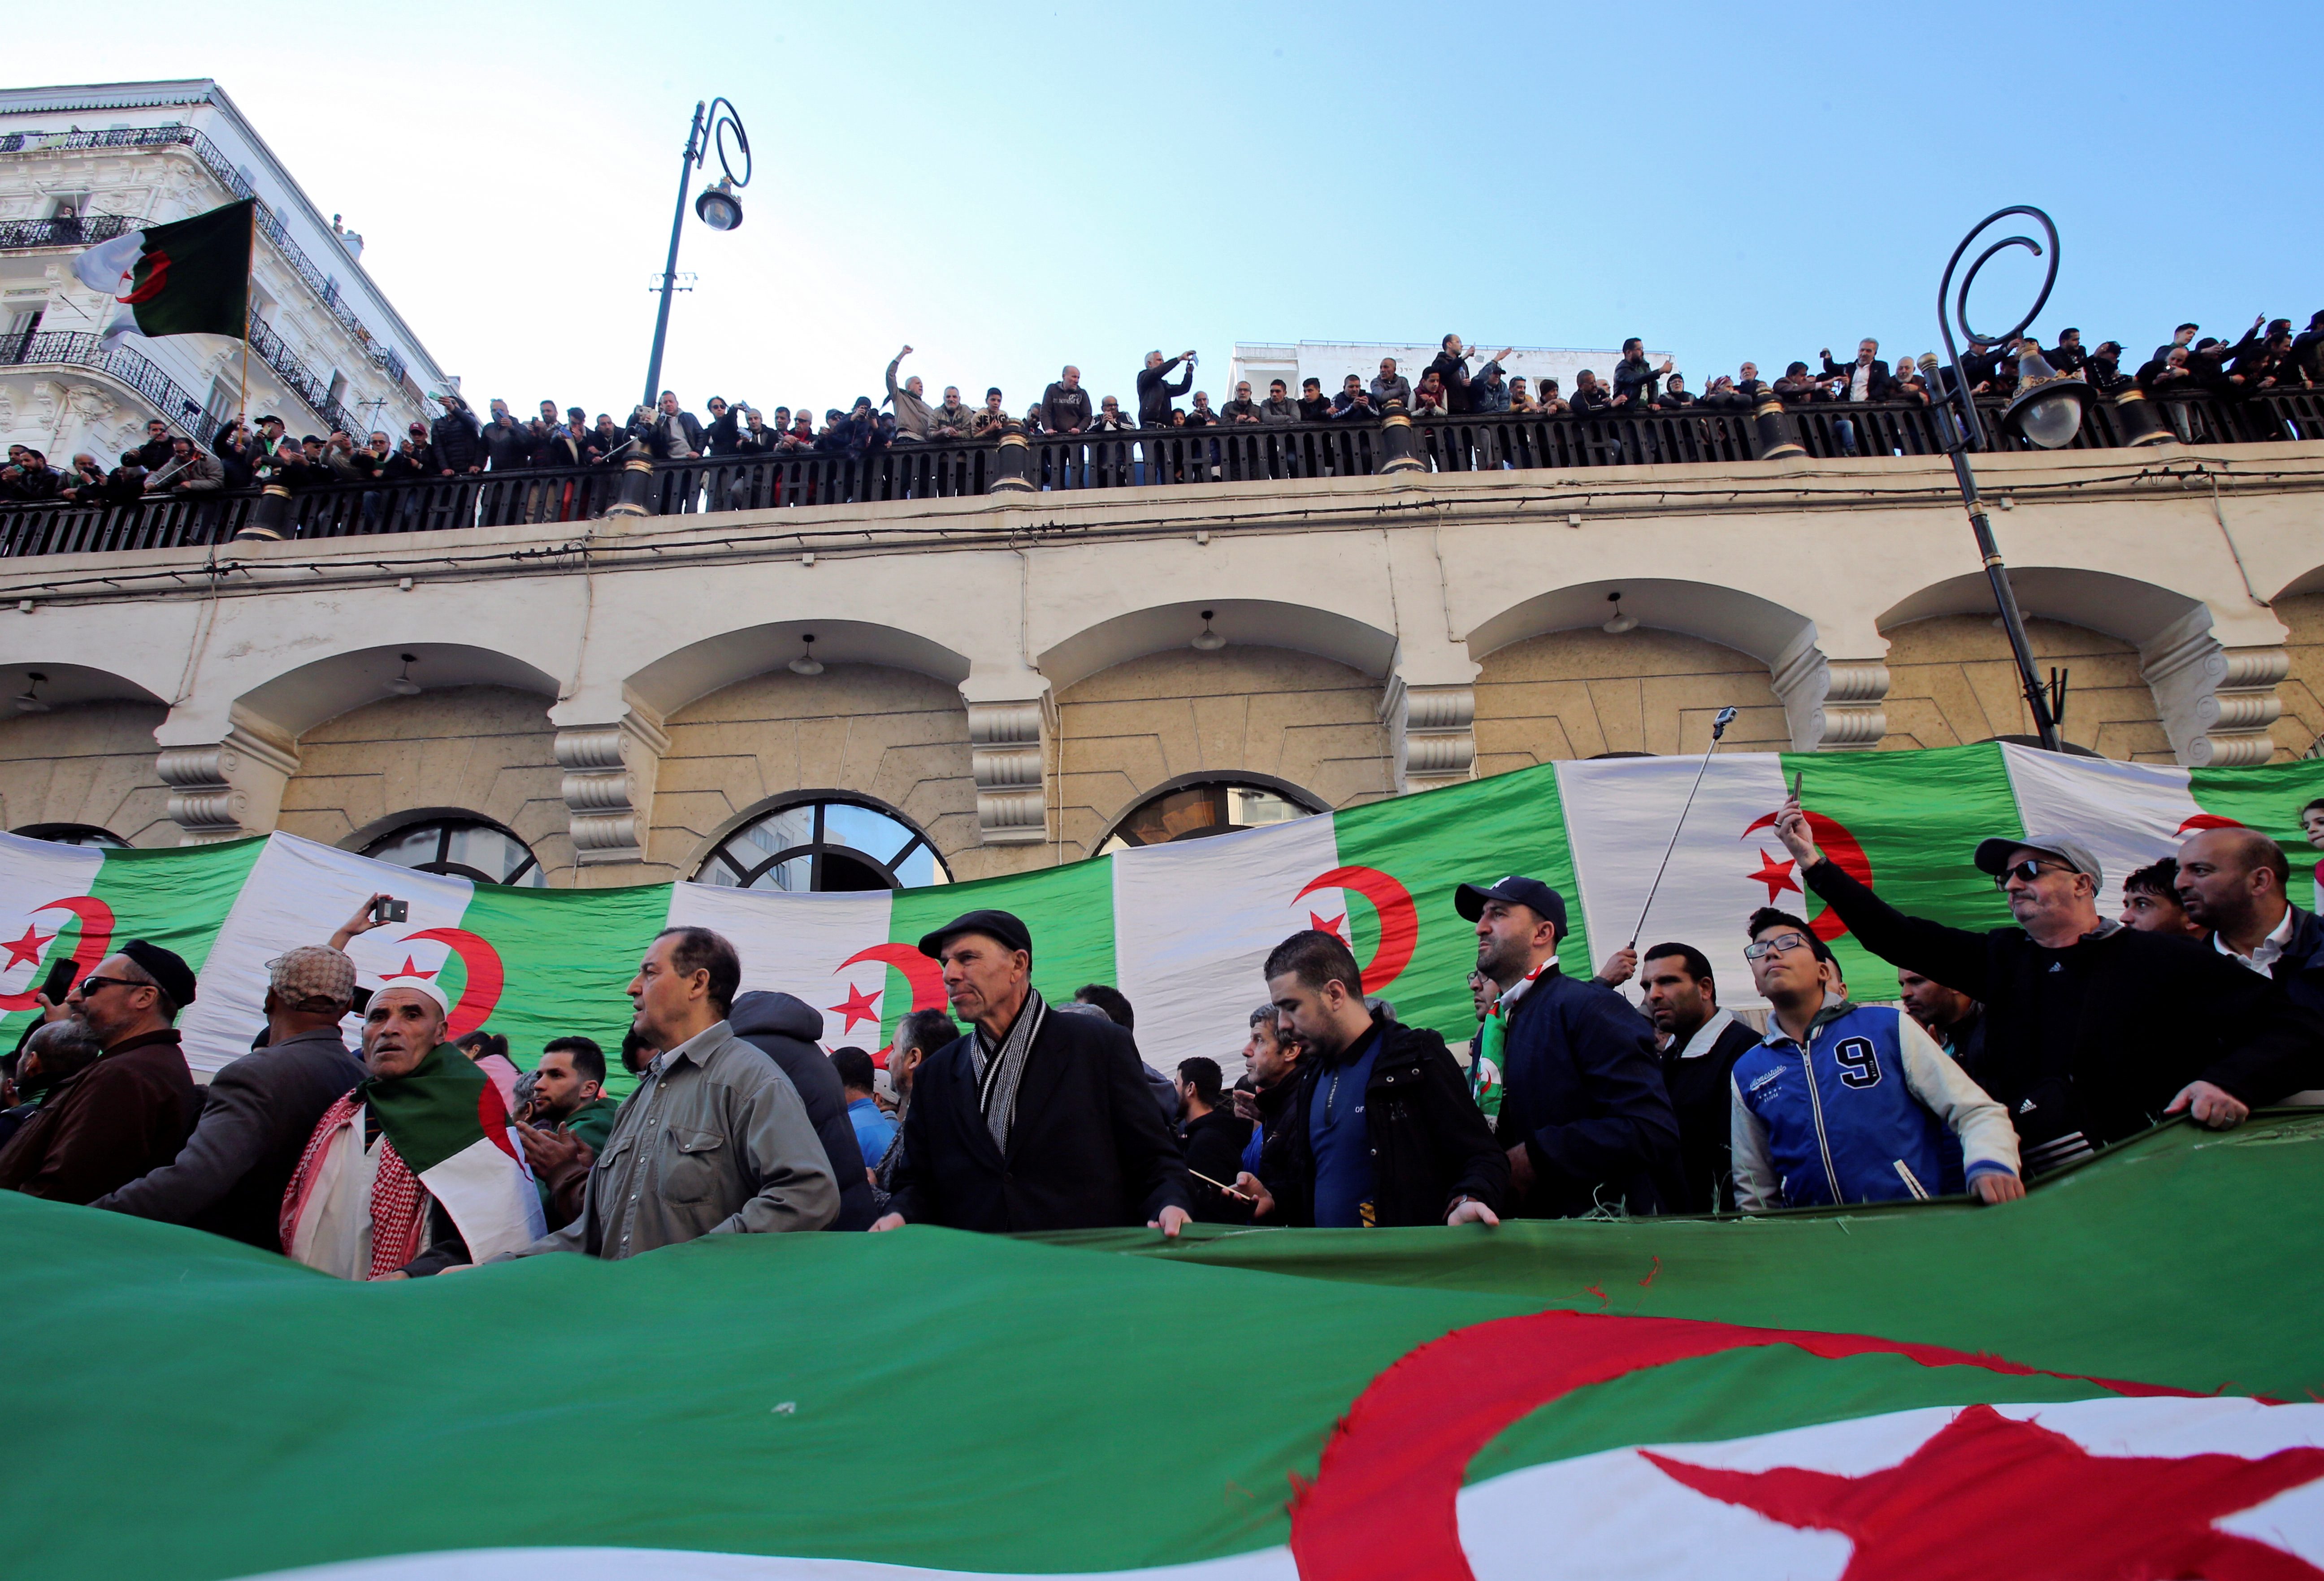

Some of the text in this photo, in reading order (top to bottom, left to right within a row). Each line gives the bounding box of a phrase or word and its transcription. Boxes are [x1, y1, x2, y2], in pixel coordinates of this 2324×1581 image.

[1833, 1035, 1882, 1089] 9
[1750, 1065, 1786, 1091] Homestate
[2019, 1104, 2037, 1114] adidas
